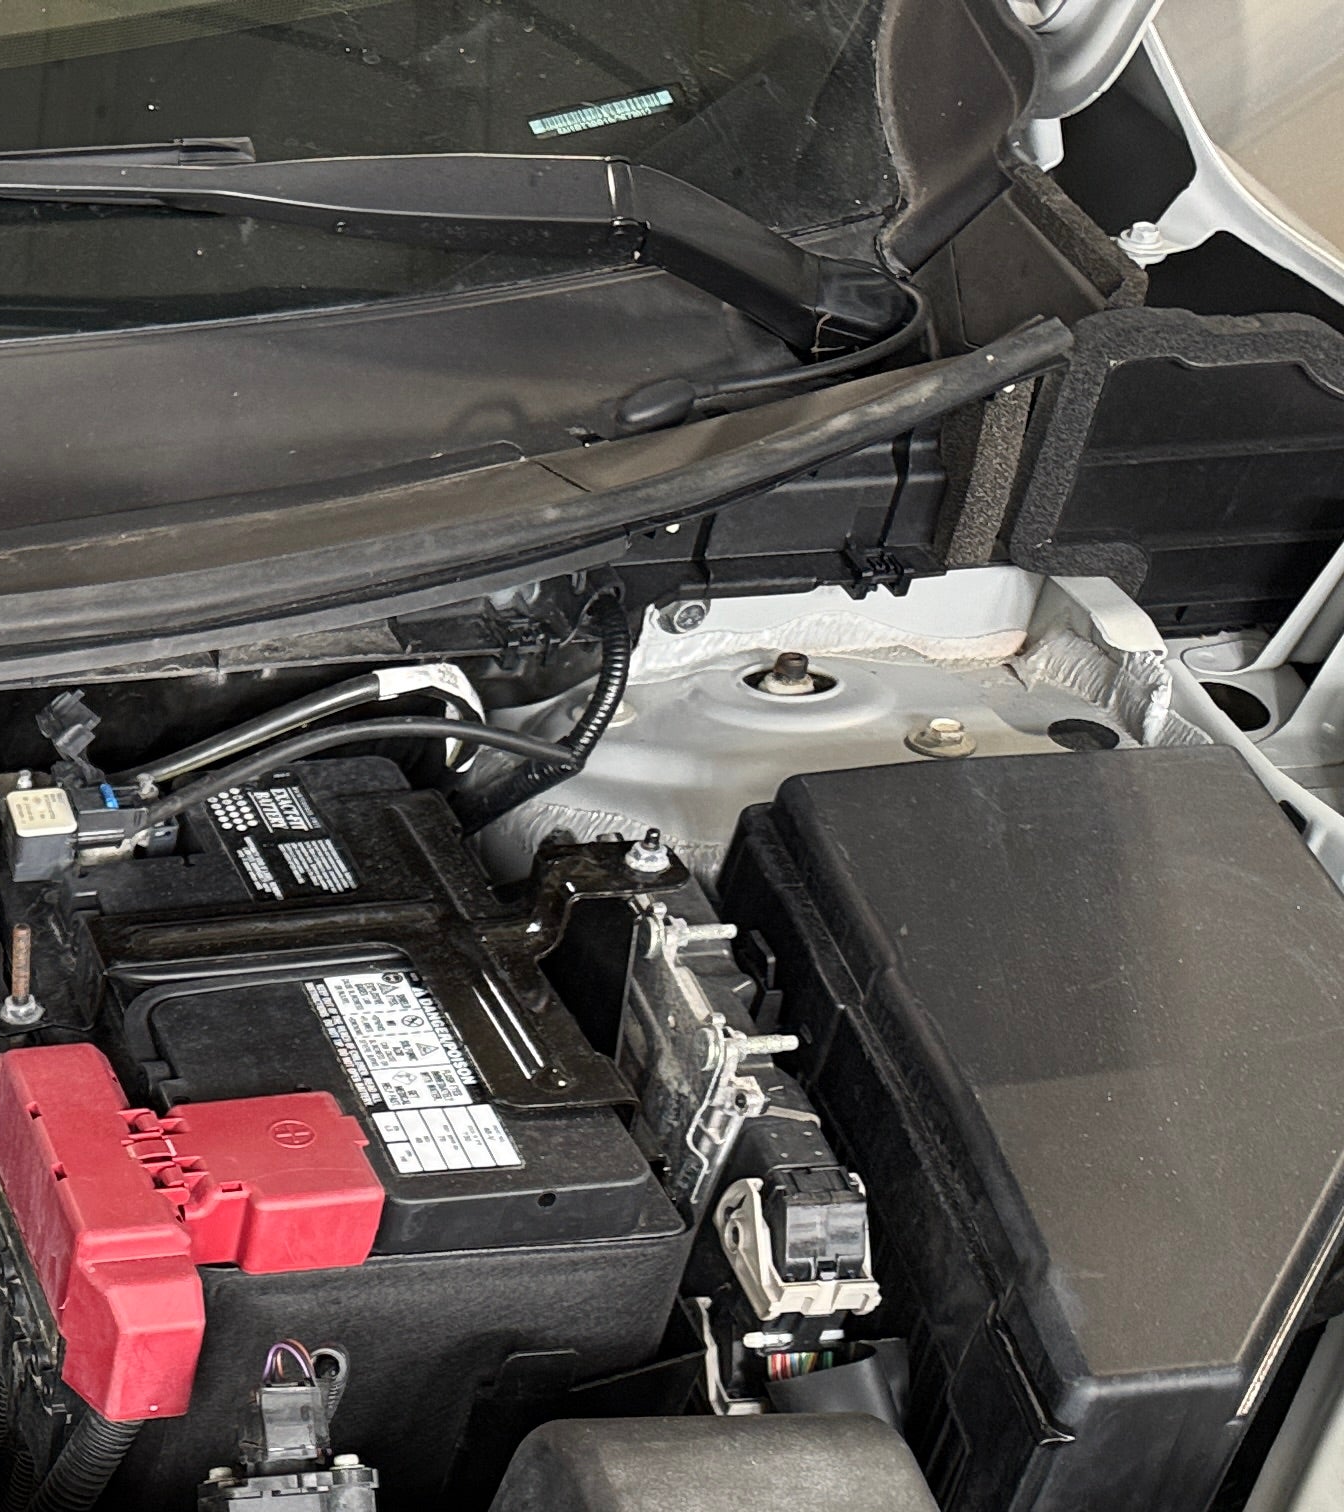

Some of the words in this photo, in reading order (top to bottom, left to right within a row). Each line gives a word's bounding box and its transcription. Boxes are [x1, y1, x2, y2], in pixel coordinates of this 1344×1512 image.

[253, 792, 289, 830] BATTERY
[270, 788, 309, 831] EXACT-FIT
[419, 997, 477, 1084] DANGER/POISON
